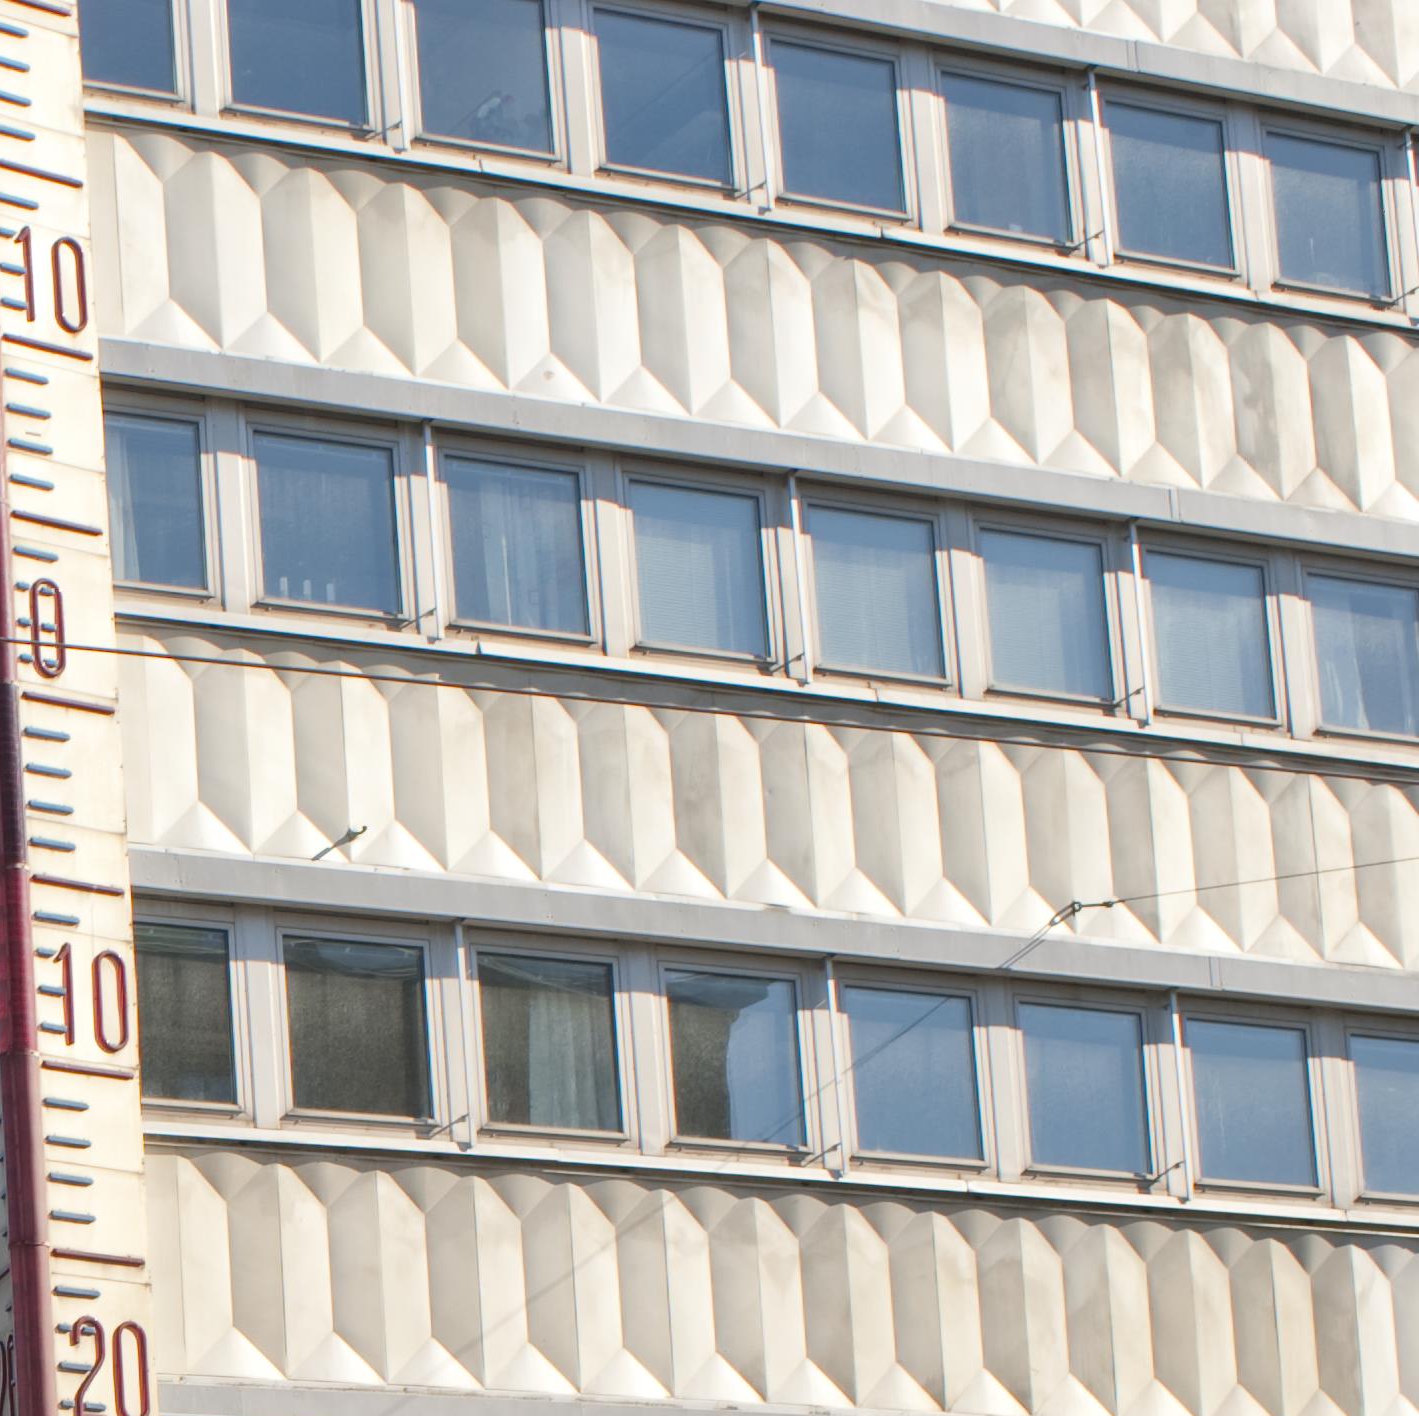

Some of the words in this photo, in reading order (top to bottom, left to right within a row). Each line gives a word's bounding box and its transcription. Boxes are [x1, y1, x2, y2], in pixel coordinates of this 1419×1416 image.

[14, 225, 88, 334] 10
[29, 577, 66, 679] 0
[53, 941, 129, 1054] 10
